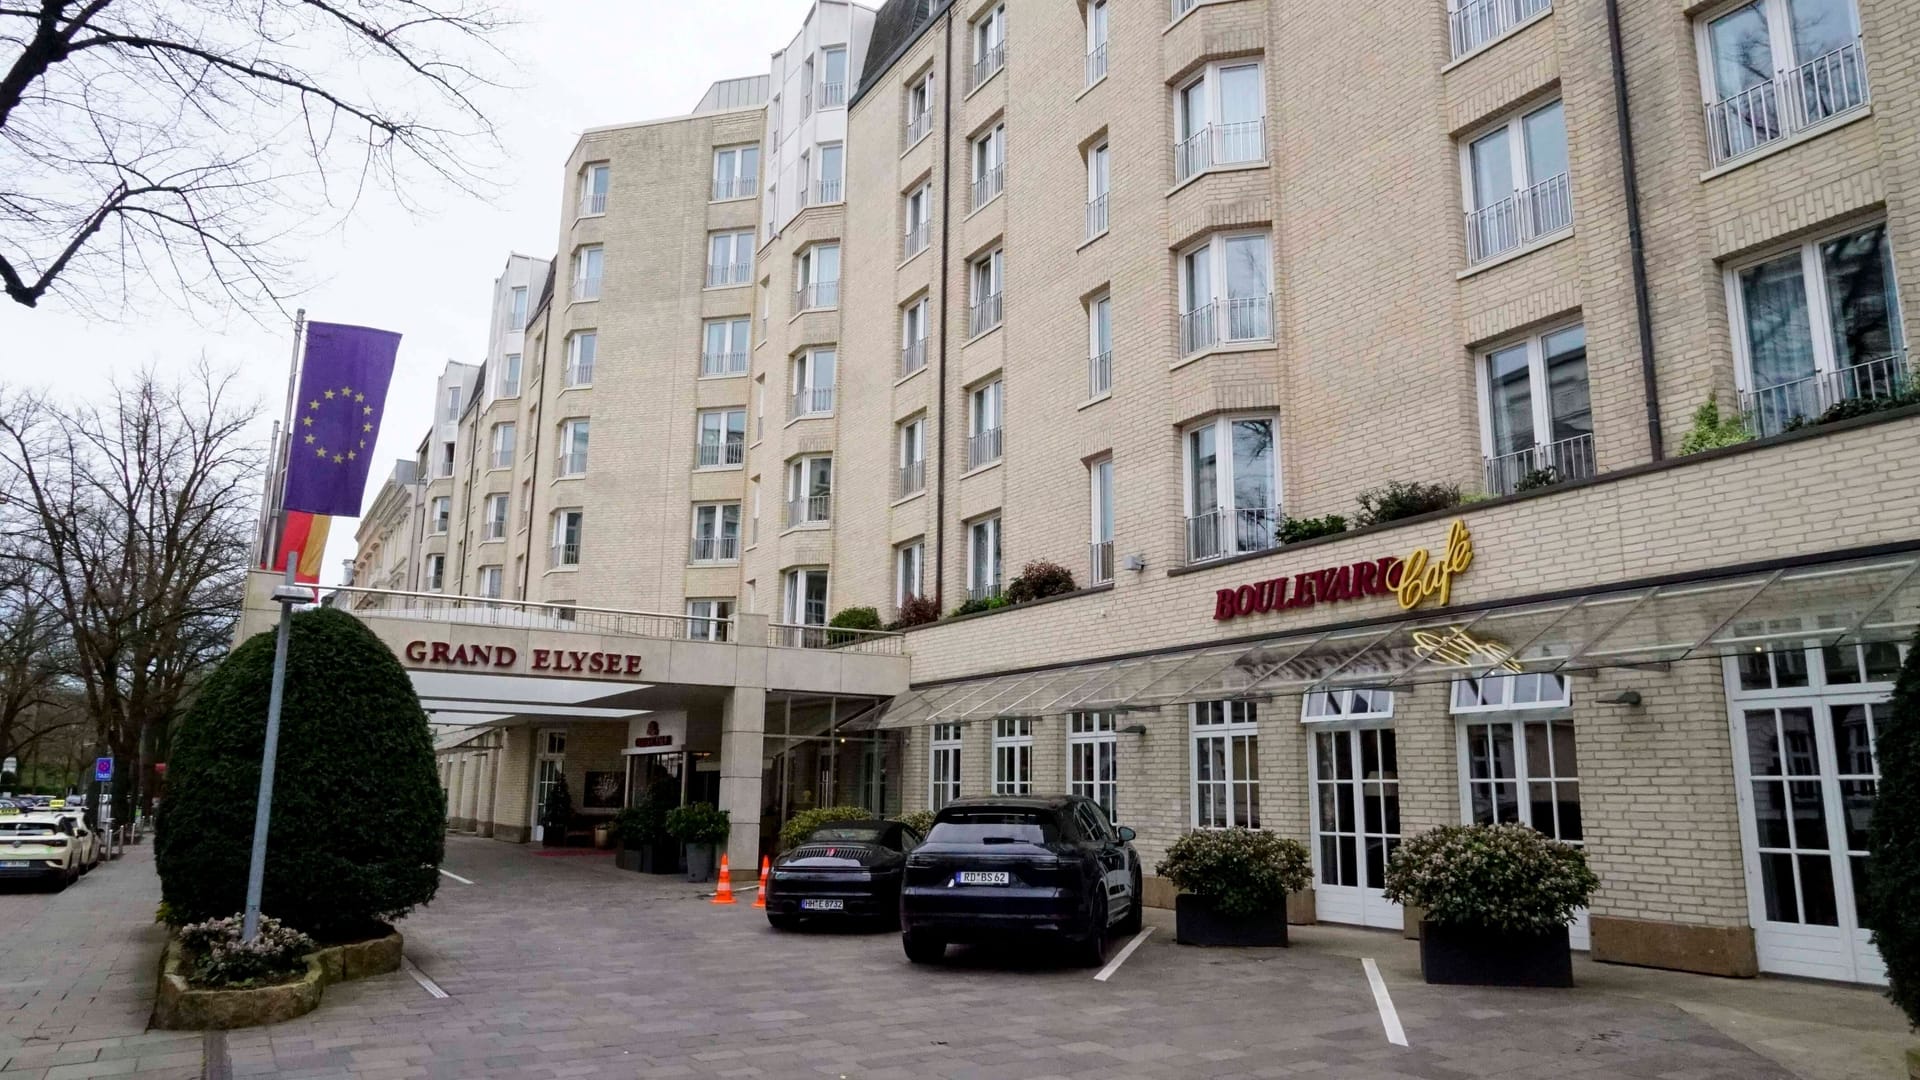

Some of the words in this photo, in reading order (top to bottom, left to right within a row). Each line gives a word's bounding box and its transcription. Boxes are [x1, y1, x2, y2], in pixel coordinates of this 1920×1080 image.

[1213, 556, 1404, 620] BOULEVARD
[1386, 519, 1473, 609] Café
[405, 640, 517, 667] GRAND
[531, 649, 643, 674] ELYSEE
